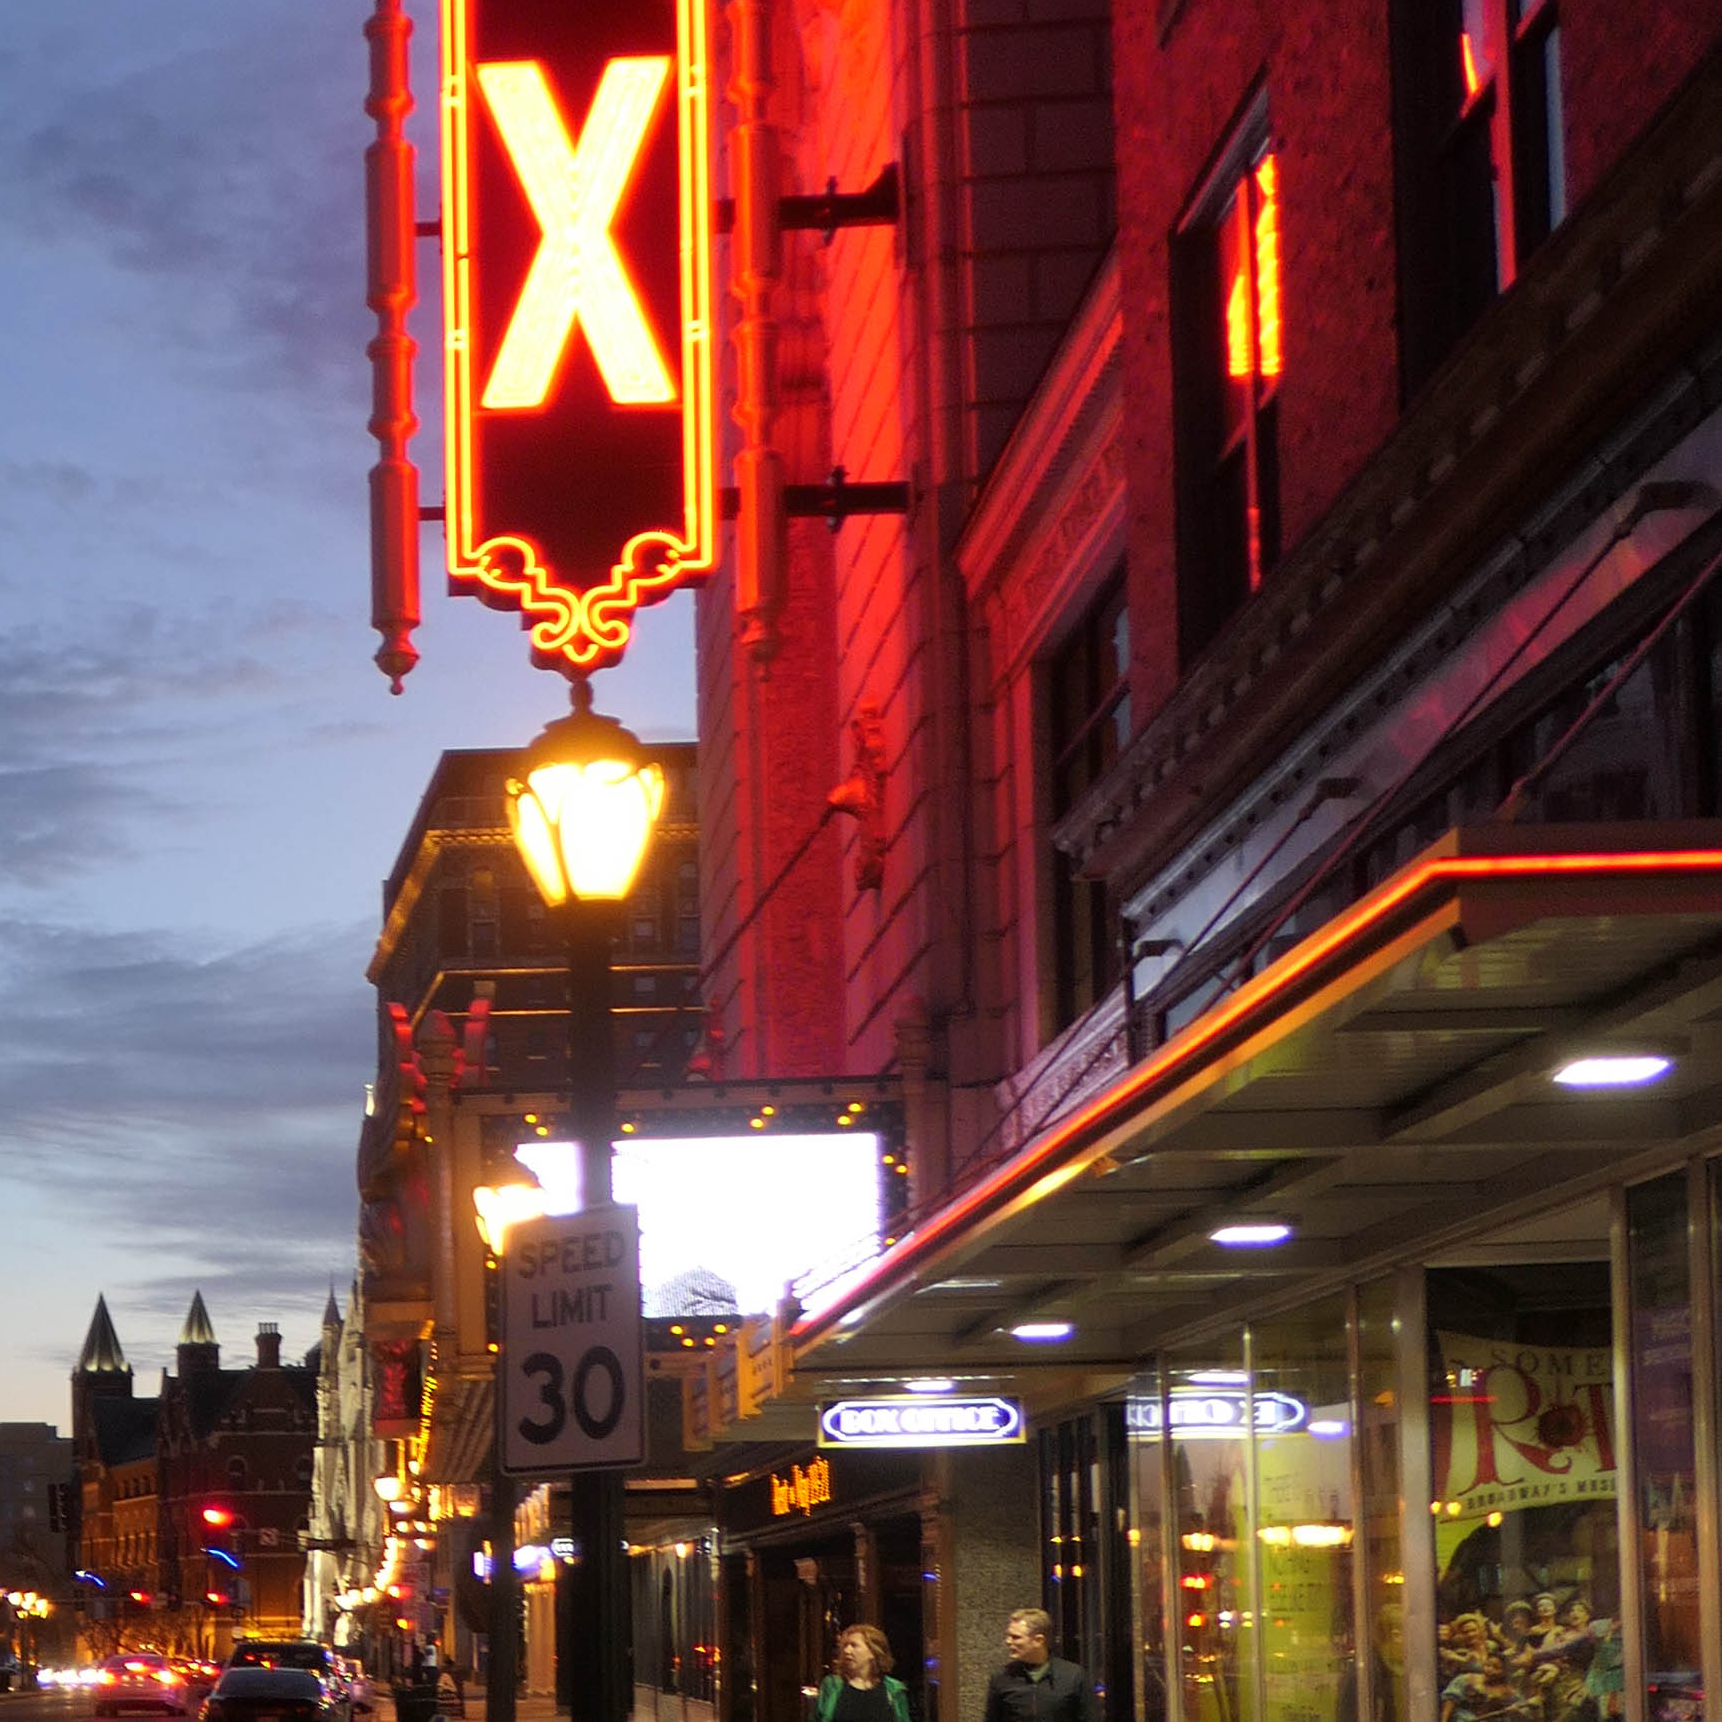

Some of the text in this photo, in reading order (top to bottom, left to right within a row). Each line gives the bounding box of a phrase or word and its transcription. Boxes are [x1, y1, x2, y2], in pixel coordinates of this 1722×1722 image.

[519, 1229, 626, 1279] SPEED
[531, 1283, 614, 1329] LIMIT
[519, 1345, 626, 1445] 30
[840, 1406, 1001, 1434] BOX OFFICE
